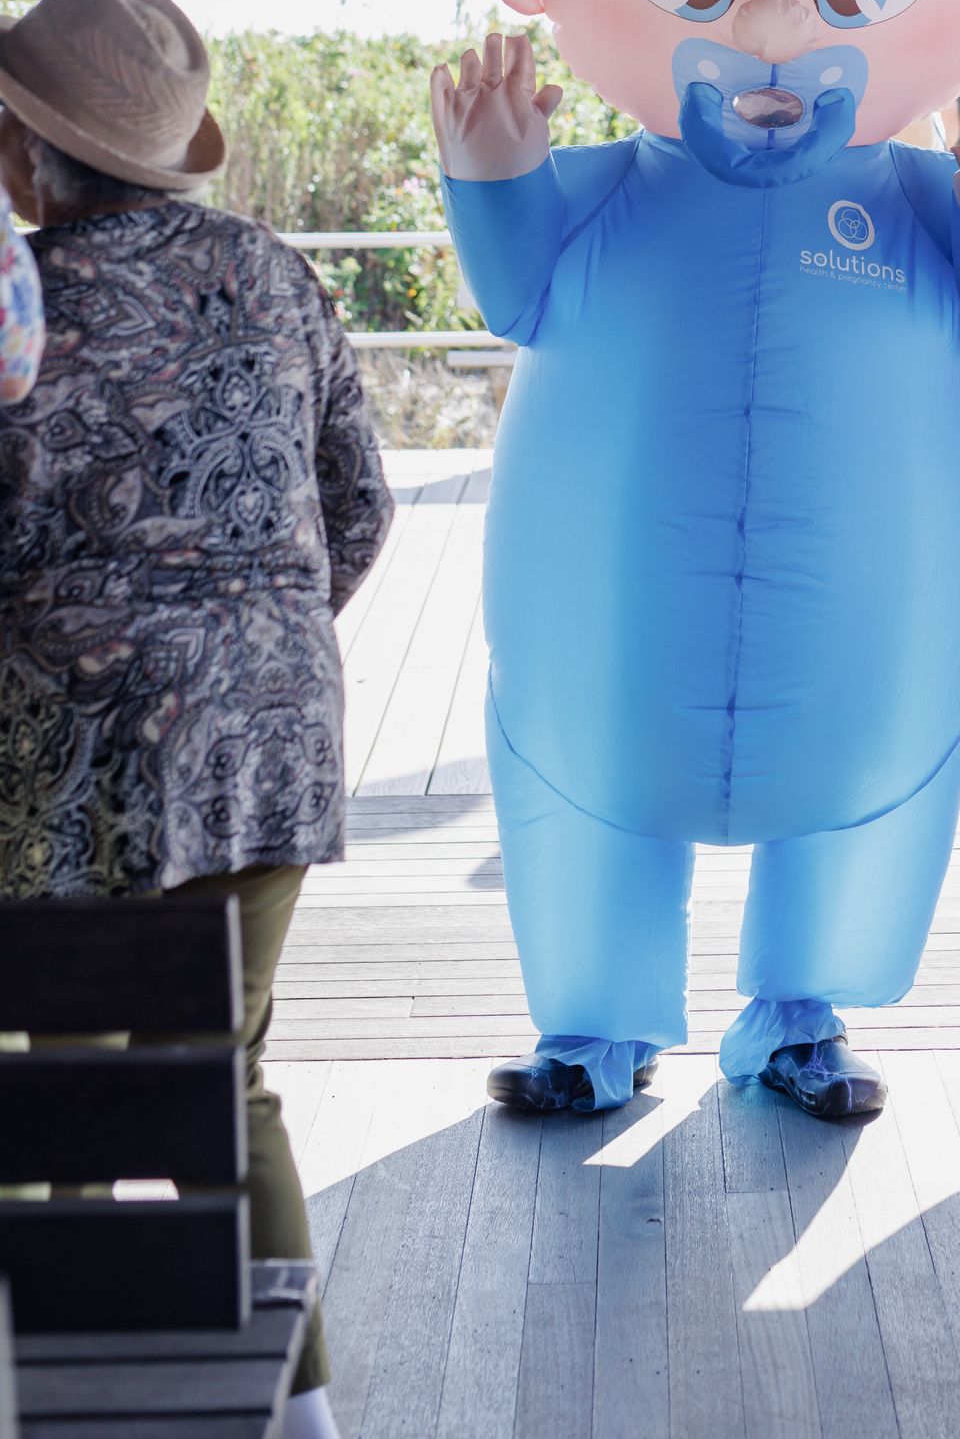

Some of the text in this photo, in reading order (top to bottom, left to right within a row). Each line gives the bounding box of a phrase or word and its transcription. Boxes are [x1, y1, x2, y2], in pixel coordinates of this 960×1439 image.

[799, 266, 828, 277] health
[838, 273, 881, 289] pregnancy
[883, 282, 906, 292] center
[800, 249, 905, 283] solutions
